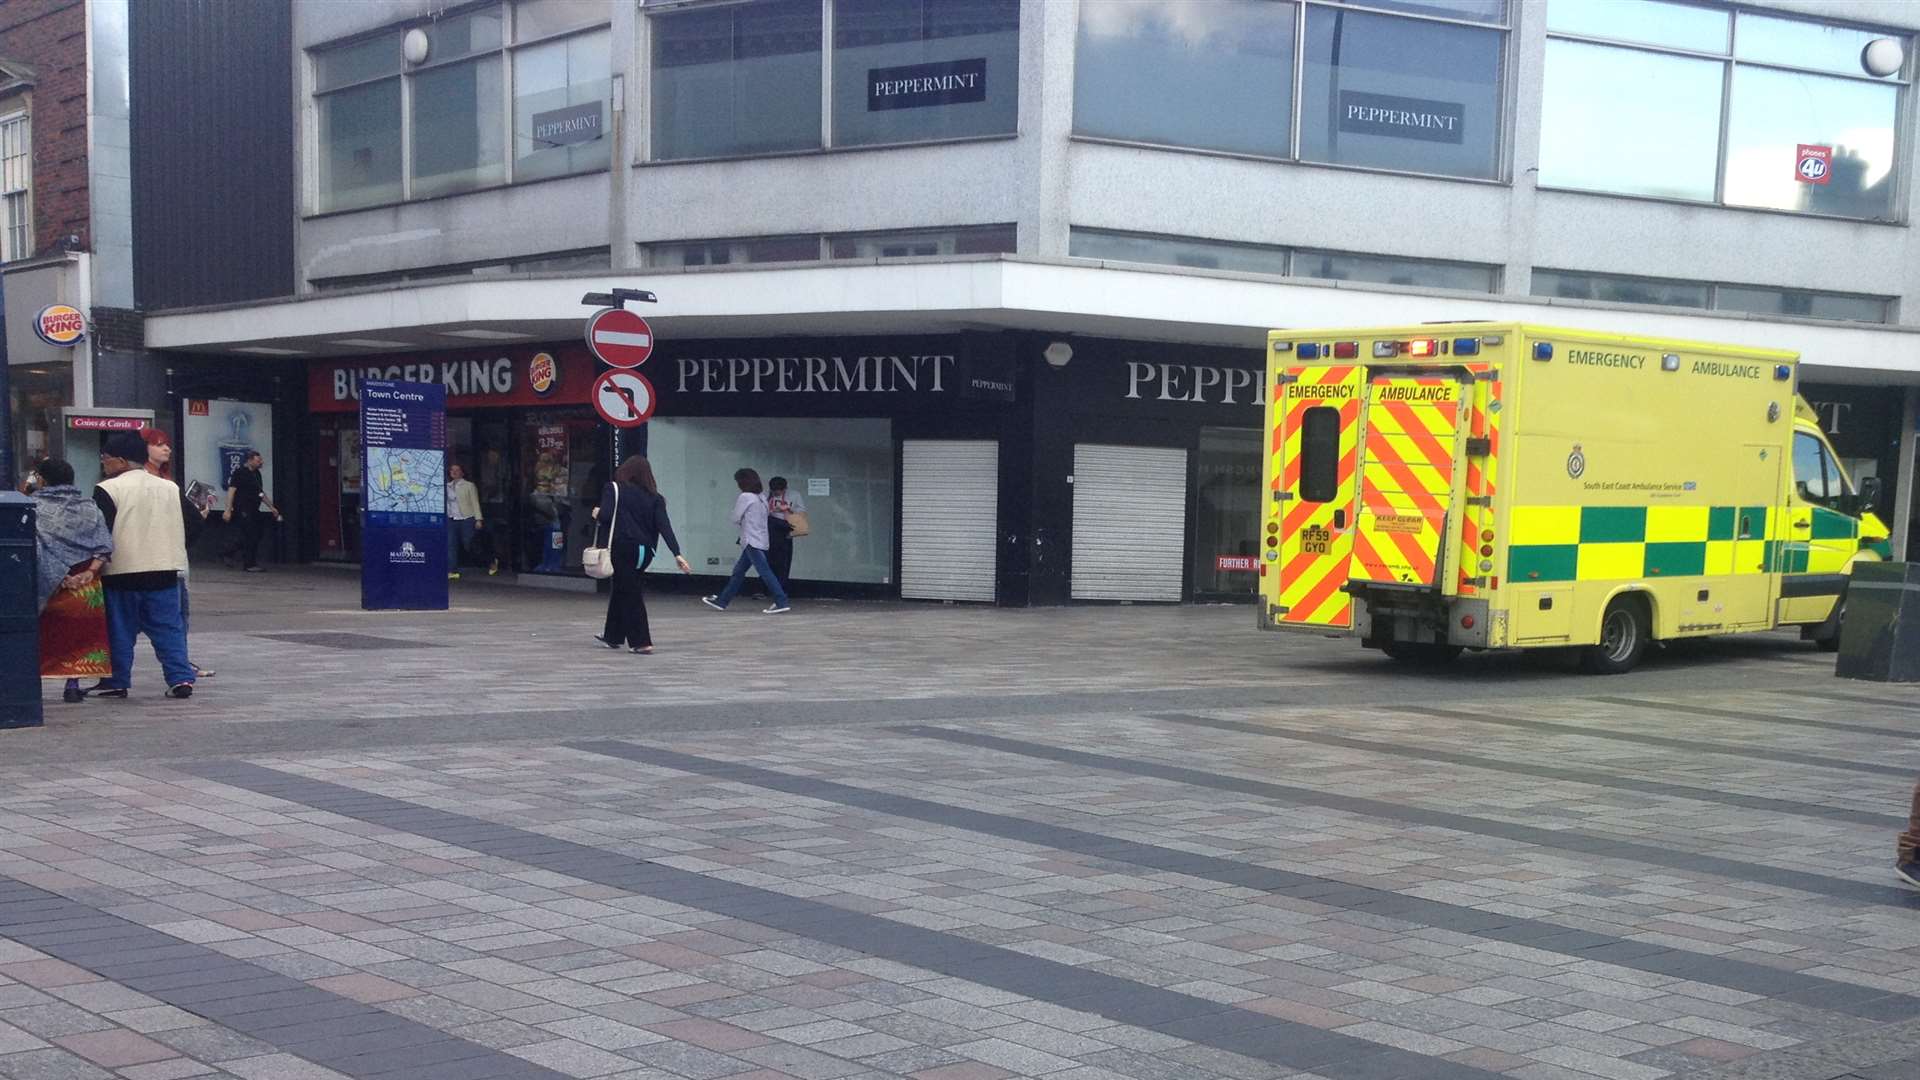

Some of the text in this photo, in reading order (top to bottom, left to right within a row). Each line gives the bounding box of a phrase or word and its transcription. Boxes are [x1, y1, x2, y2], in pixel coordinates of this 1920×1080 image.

[875, 73, 978, 96] PEPPERMINT
[1348, 105, 1457, 130] PEPPERMINT
[536, 114, 598, 138] PEPPERMINT
[1801, 149, 1825, 158] phones
[43, 313, 80, 324] BURGER
[44, 320, 82, 335] KING
[1568, 350, 1760, 379] EMERGENCY AMBULANCE
[441, 358, 512, 397] KING
[676, 355, 955, 393] PEPPERMINT
[971, 379, 1014, 392] PEPPERMINT
[1289, 385, 1451, 400] EMERGENCY AMBULANCE
[367, 389, 424, 402] Town Centre
[1583, 481, 1600, 490] South
[1602, 481, 1614, 490] East
[1615, 481, 1631, 490] Coast
[1632, 481, 1662, 490] Ambulance
[1663, 481, 1682, 490] Service
[1302, 529, 1329, 541] RF59
[1219, 557, 1249, 569] FURTHER
